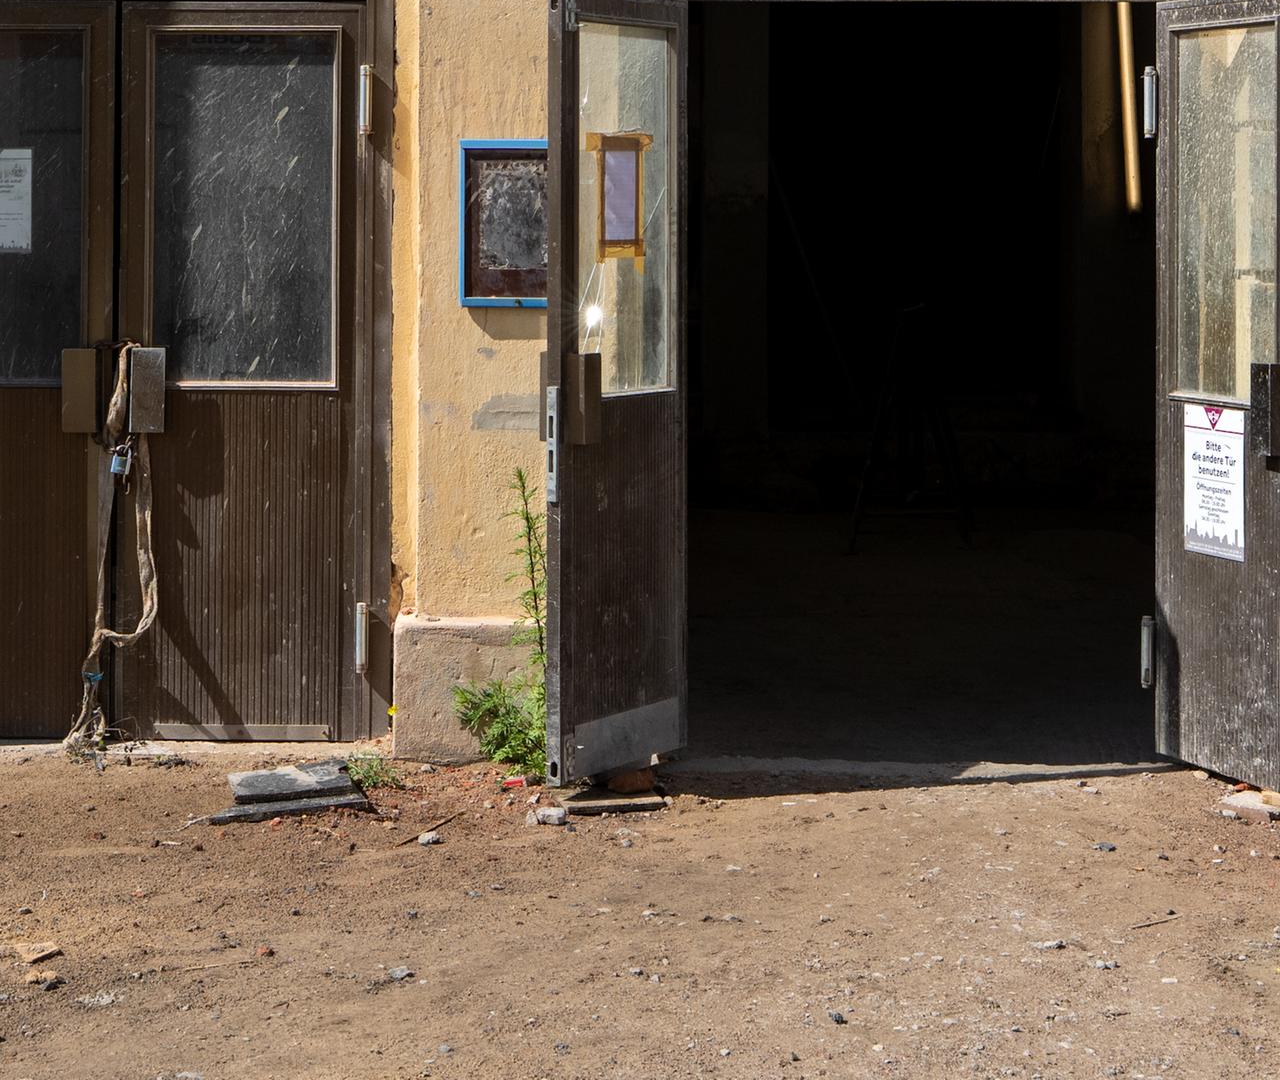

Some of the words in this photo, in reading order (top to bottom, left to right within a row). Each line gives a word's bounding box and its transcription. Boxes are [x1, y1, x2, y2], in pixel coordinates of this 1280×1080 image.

[1206, 440, 1221, 452] Bitte
[1192, 452, 1201, 461] die
[1202, 454, 1223, 465] andere
[1225, 456, 1236, 467] Tür
